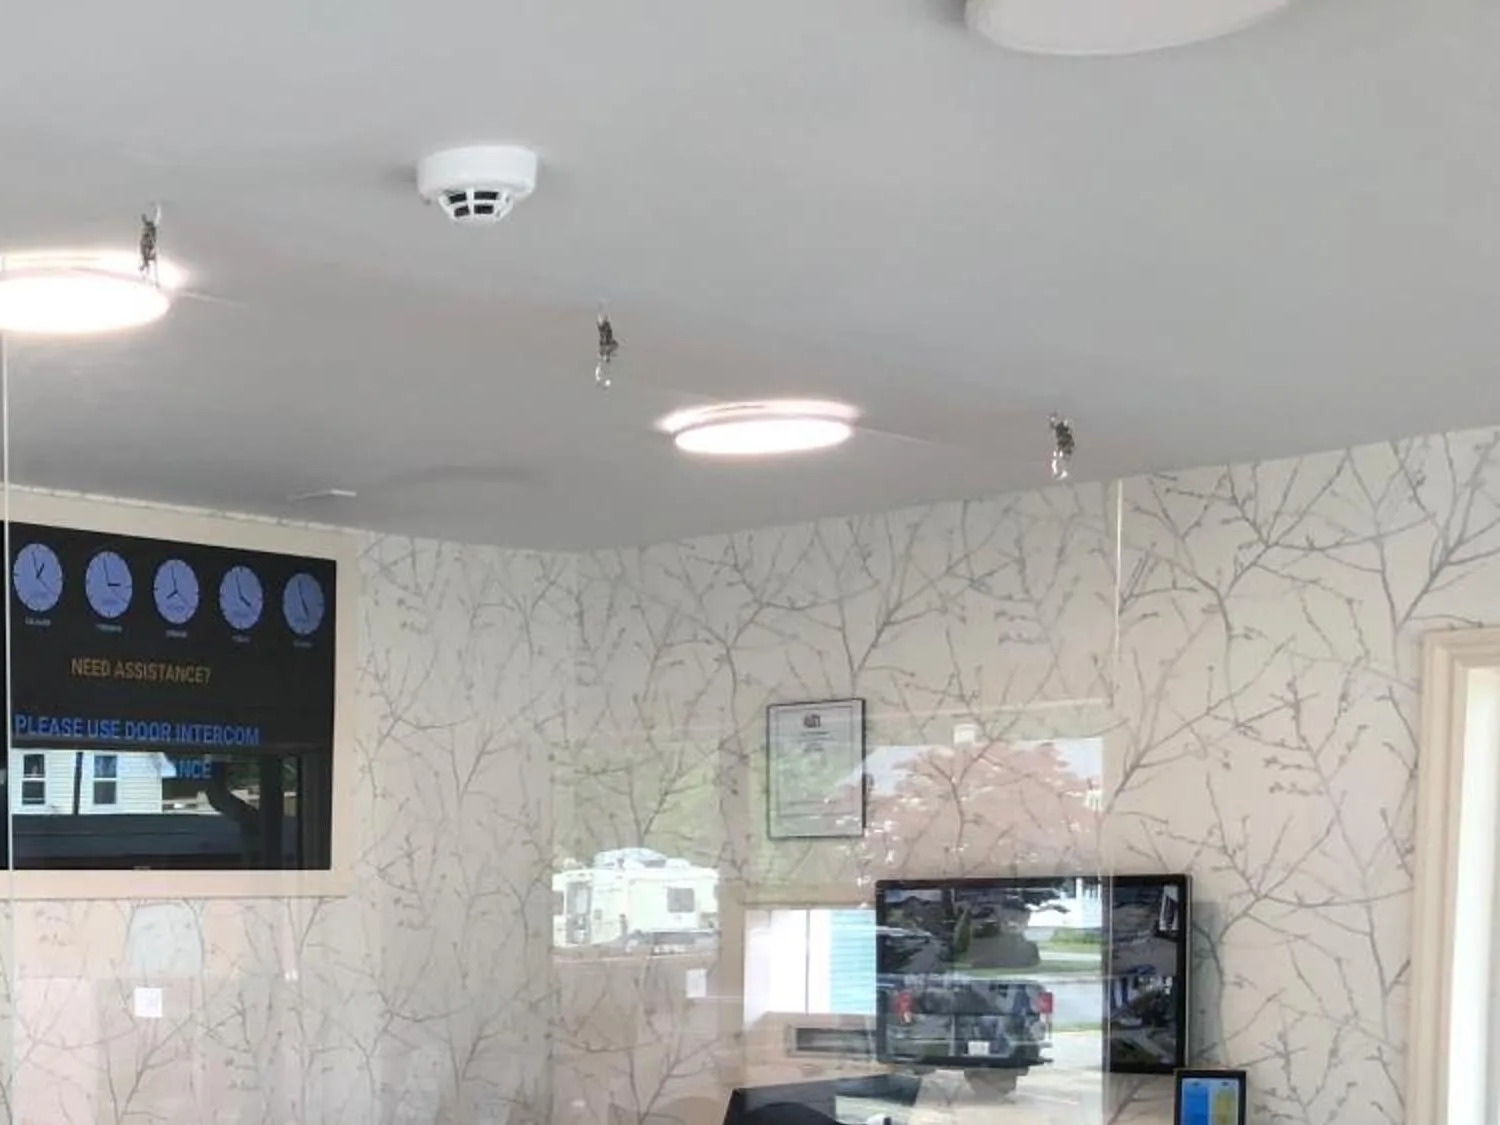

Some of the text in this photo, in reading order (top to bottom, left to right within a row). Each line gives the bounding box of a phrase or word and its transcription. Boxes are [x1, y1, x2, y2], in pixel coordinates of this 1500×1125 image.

[71, 658, 211, 684] NEED ASSISTANCE?
[15, 714, 260, 746] PLEASE USE DOOR INTERCOM
